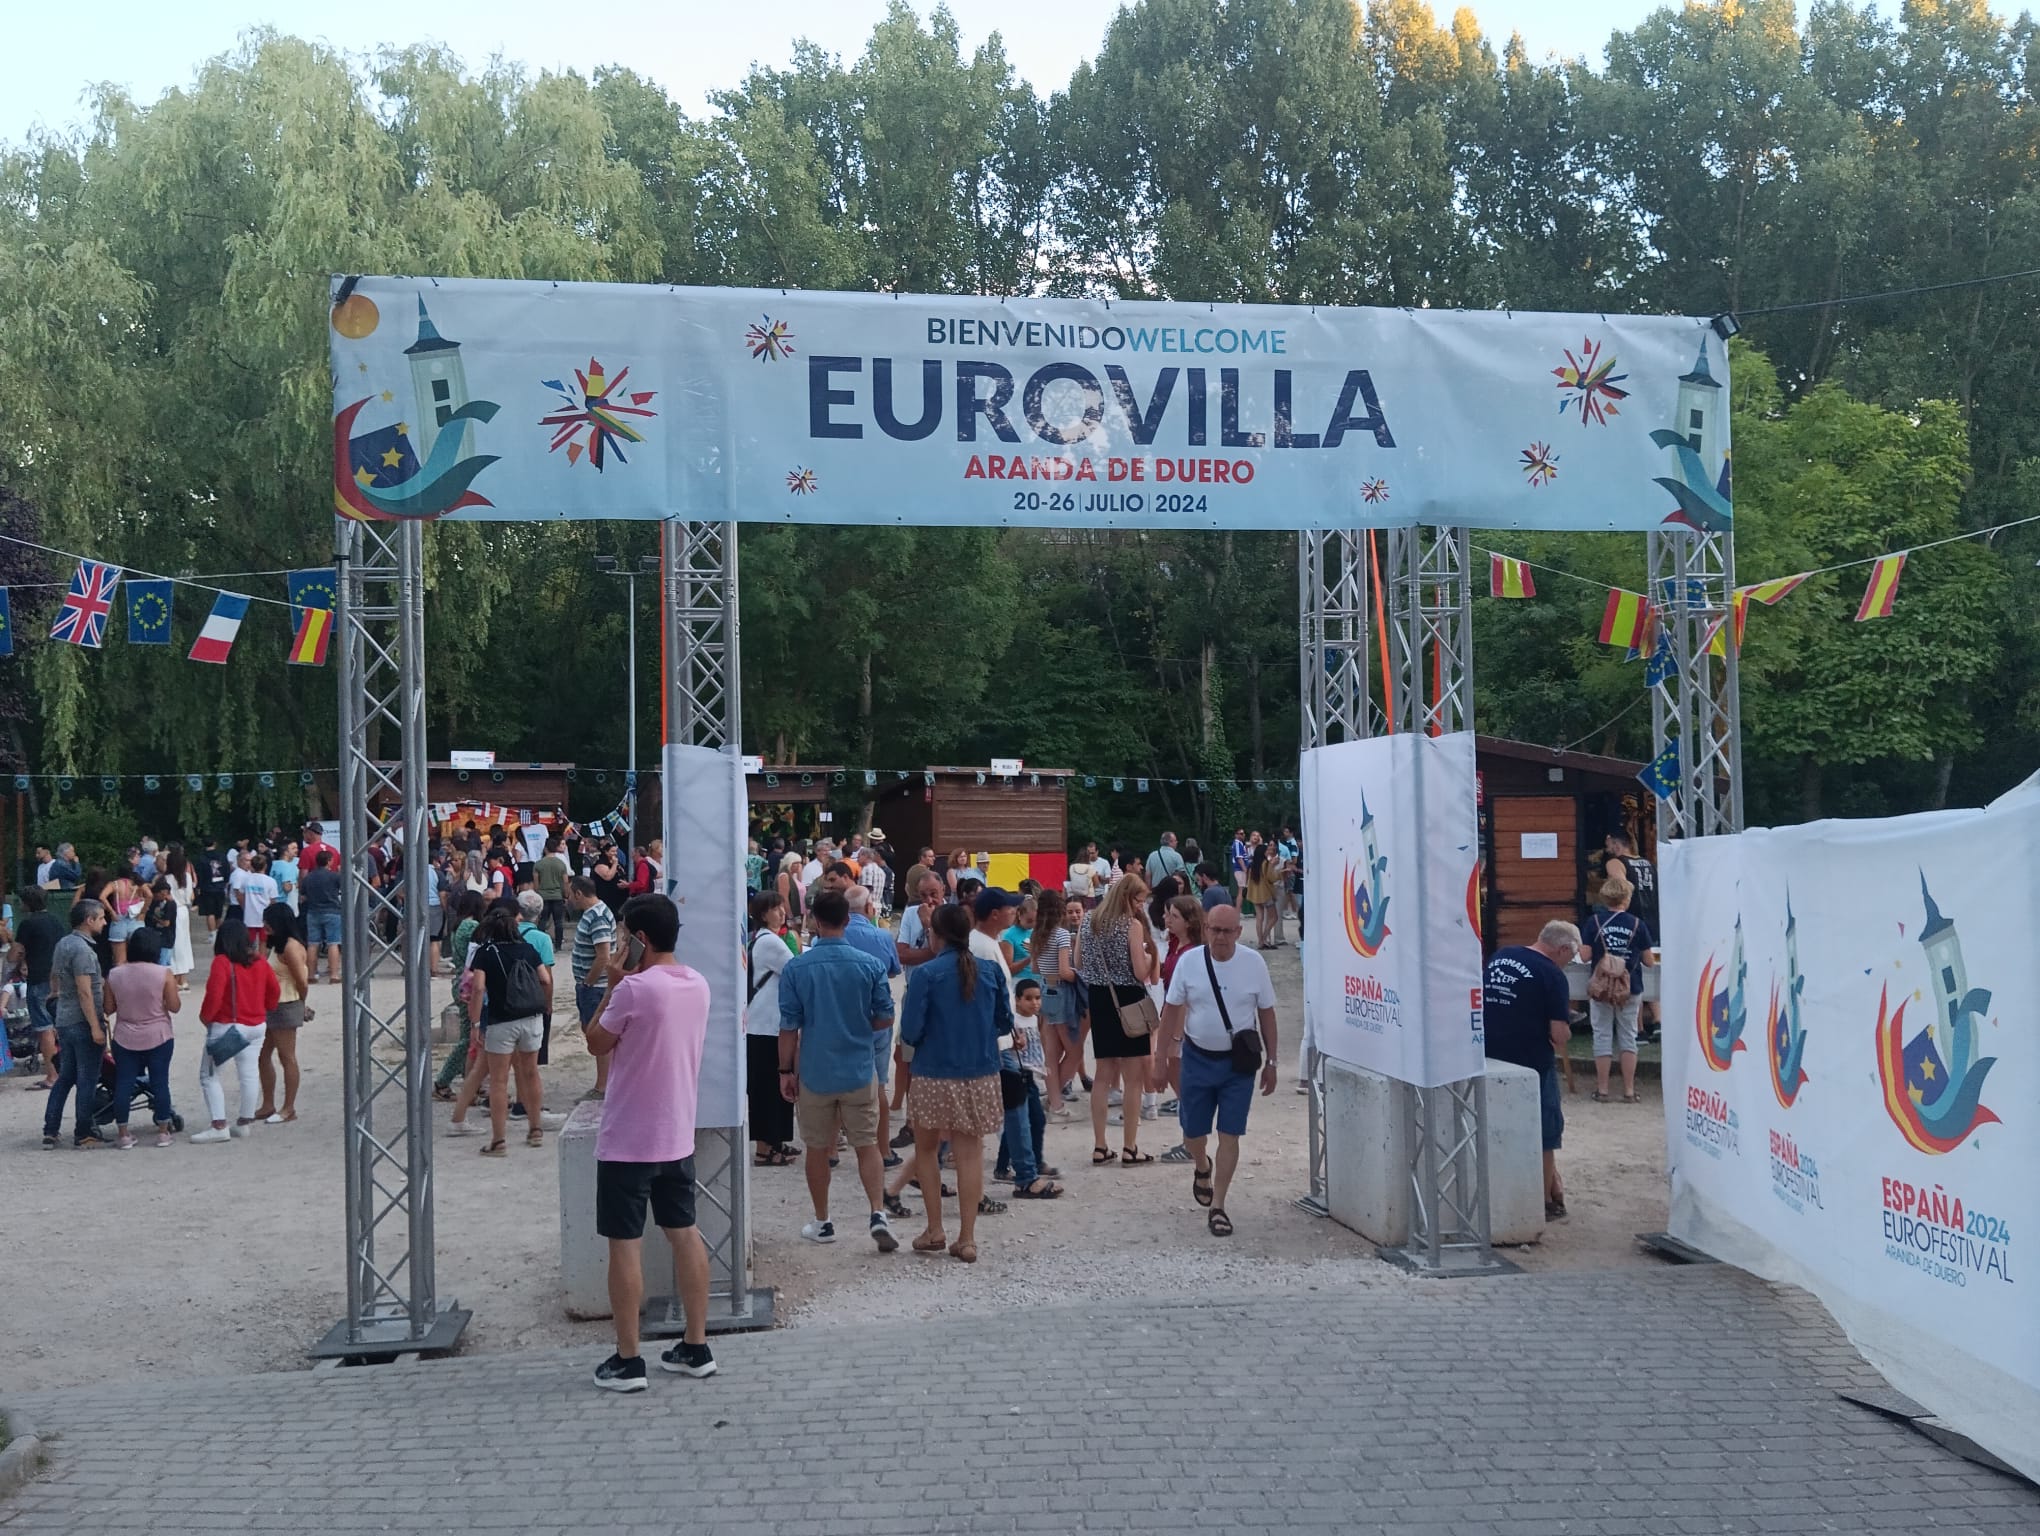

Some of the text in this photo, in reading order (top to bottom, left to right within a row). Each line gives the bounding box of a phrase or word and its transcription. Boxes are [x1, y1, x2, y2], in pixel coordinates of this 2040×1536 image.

[808, 355, 1397, 449] EUROVILLA
[964, 454, 1255, 484] ARANDA DE DUERO
[1014, 492, 1208, 513] 20-26 JULIO 2024
[1634, 867, 1653, 891] 14
[1345, 975, 1383, 1003] ESPAÑA
[1345, 996, 1403, 1027] EUROFESTIVAL
[1688, 1085, 1727, 1124] ESPAÑA
[1769, 1128, 1800, 1170] ESPAÑA
[1882, 1176, 2011, 1246] ESPAÑA 2024
[1883, 1210, 2014, 1284] EUROFESTIVAL
[1886, 1244, 1921, 1269] ARANDA
[1933, 1262, 1966, 1288] DUERO
